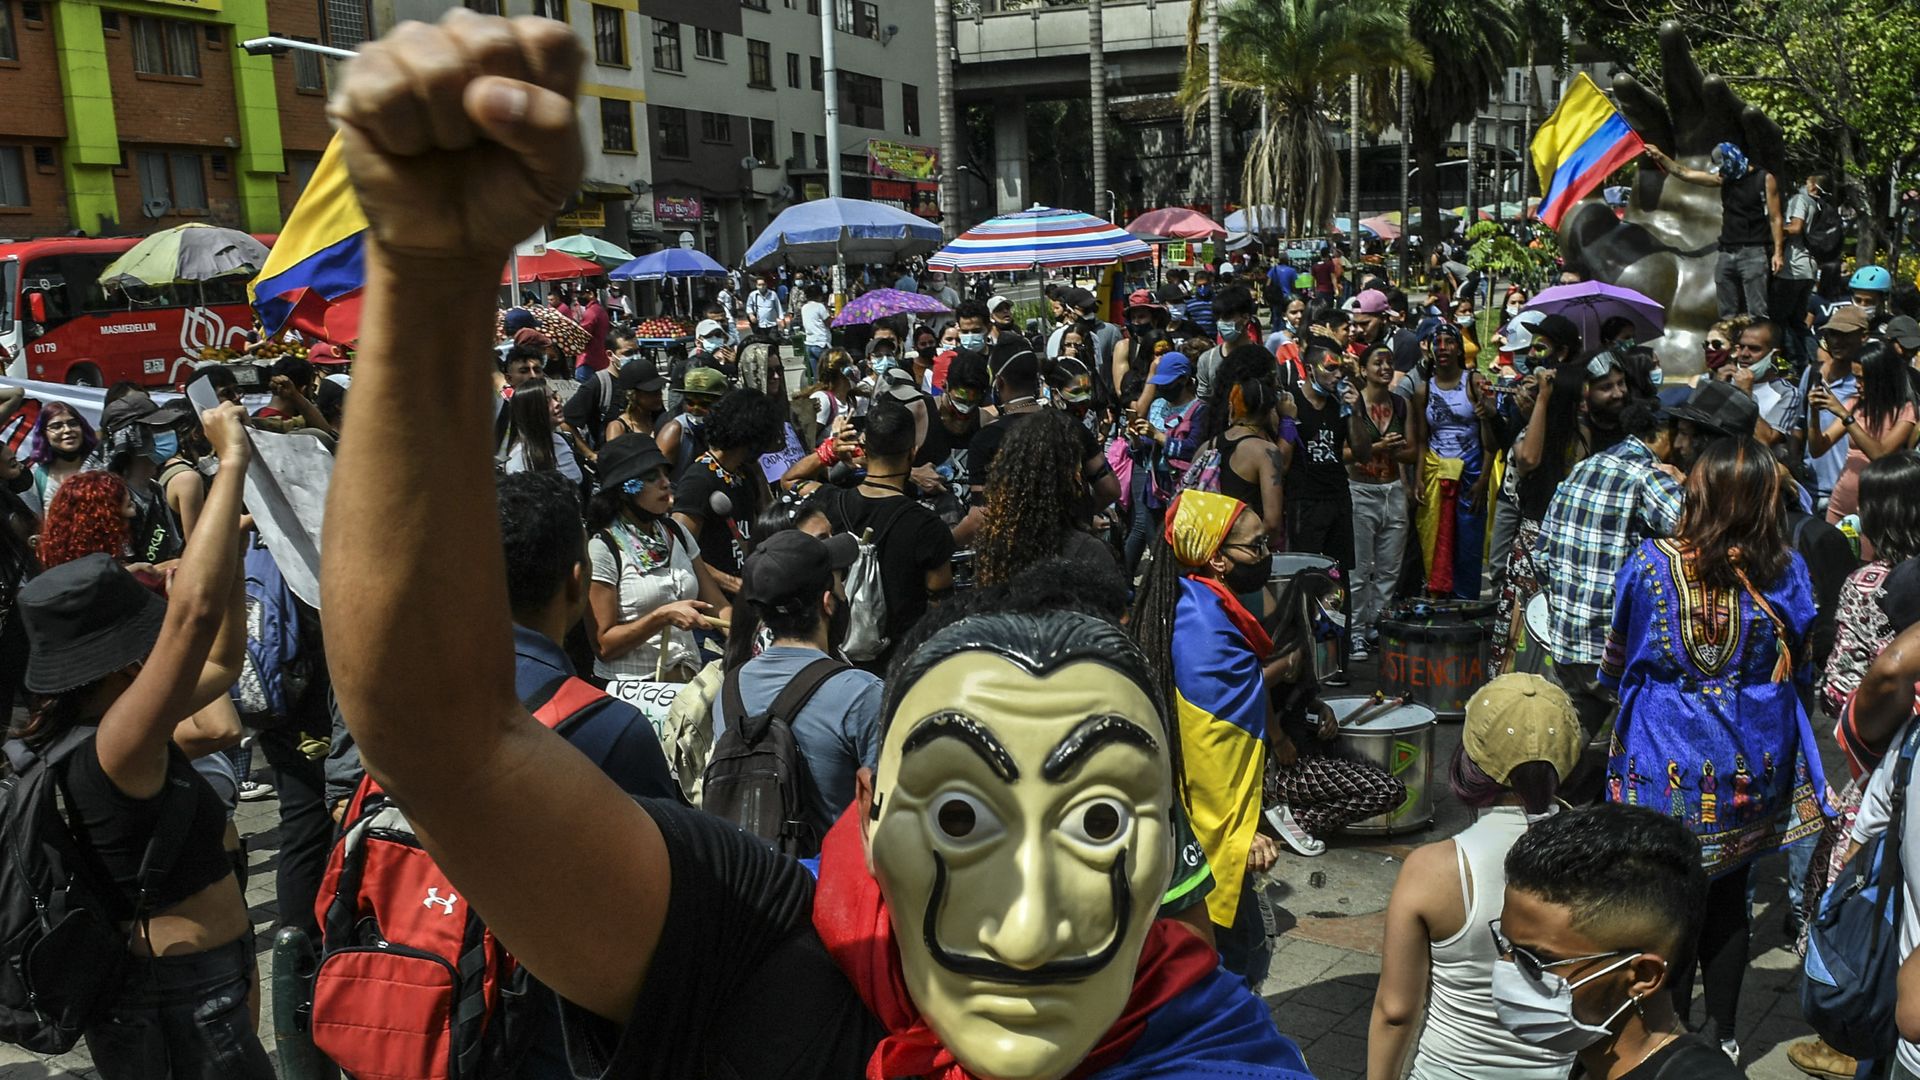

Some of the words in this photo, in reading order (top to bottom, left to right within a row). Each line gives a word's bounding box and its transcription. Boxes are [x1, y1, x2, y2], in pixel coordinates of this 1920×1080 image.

[659, 202, 674, 215] Play
[675, 204, 689, 216] Boy
[99, 322, 157, 335] MASMEDELLIN
[34, 342, 57, 354] 0179
